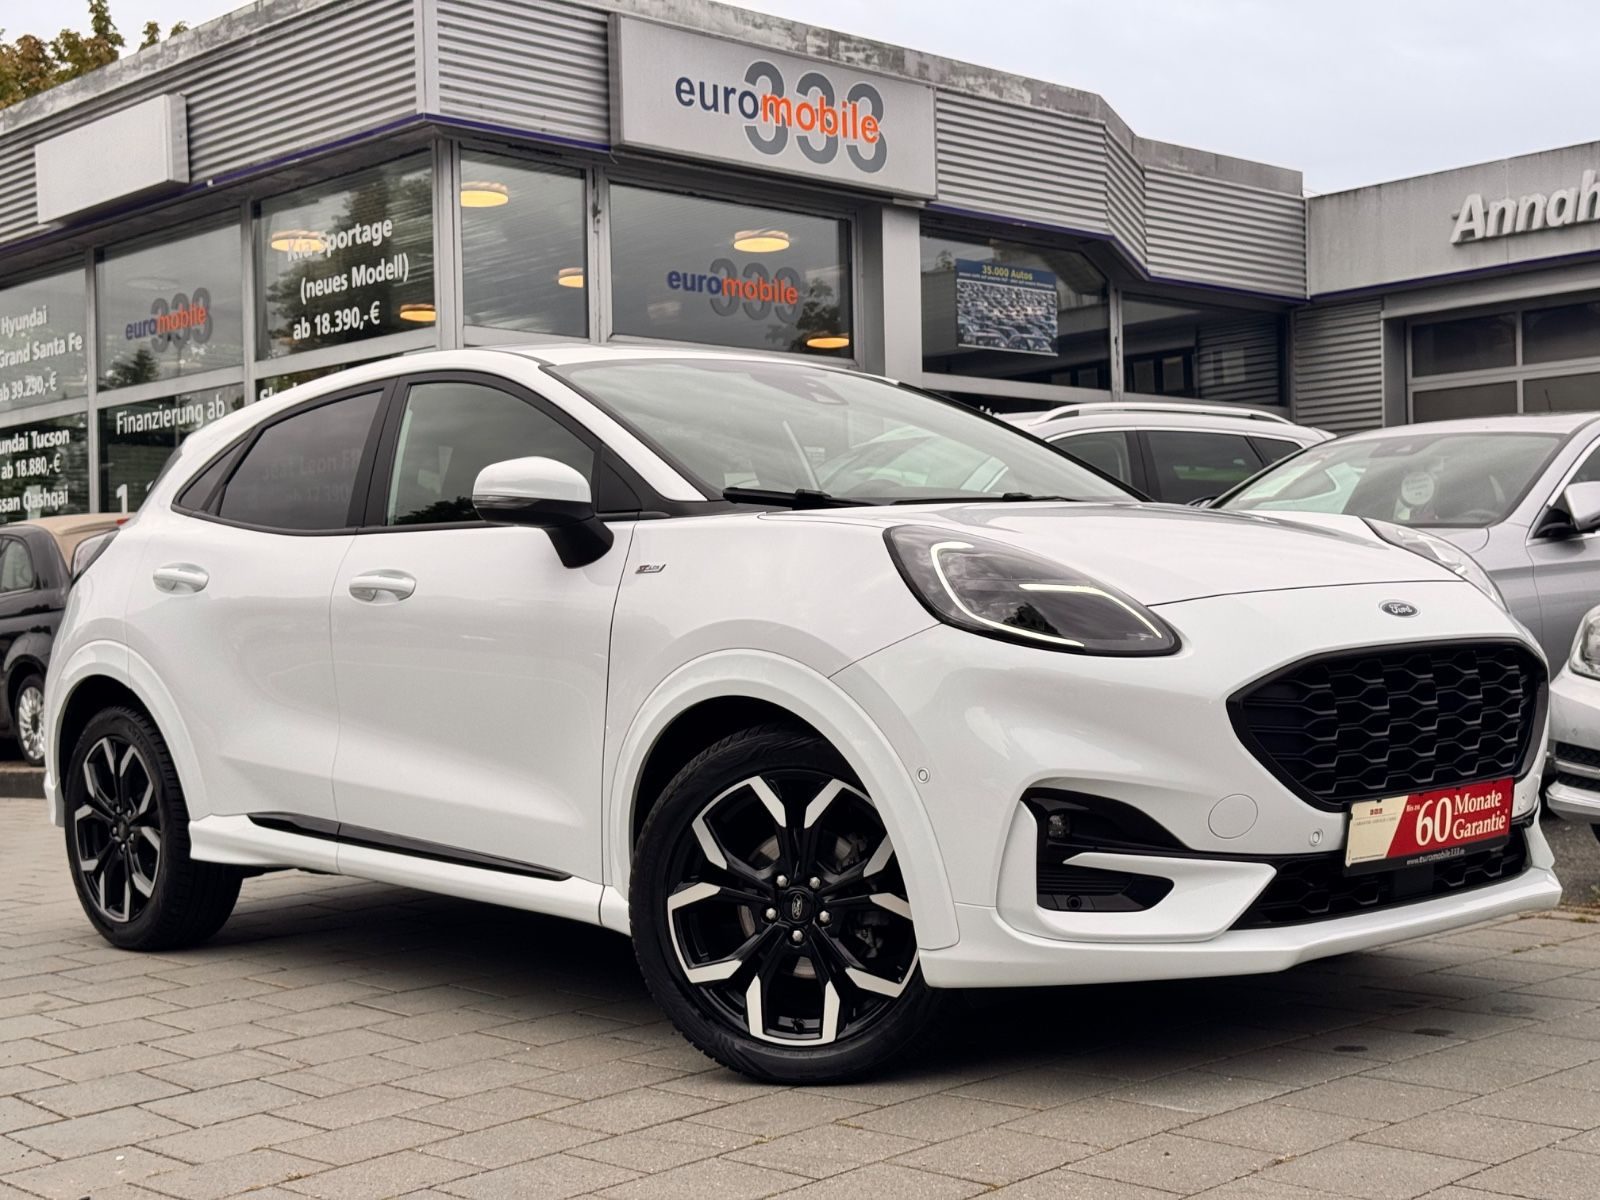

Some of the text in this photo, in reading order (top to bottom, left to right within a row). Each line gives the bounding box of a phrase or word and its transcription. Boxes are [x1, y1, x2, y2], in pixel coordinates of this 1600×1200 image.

[675, 76, 880, 144] euromobile
[744, 61, 887, 173] 333
[1450, 169, 1600, 244] Annah
[319, 219, 393, 257] Sportage
[300, 252, 409, 304] (neues Modell)
[667, 270, 798, 305] euromobile
[982, 264, 1009, 277] 35.000
[1010, 269, 1033, 281] Autos
[1, 304, 47, 338] Hyundai
[126, 302, 208, 340] euromobile
[293, 317, 310, 340] ab
[32, 336, 66, 360] Santa
[68, 332, 83, 352] Fe
[116, 394, 225, 435] Finanzierung ab
[31, 429, 70, 450] Tucson
[1, 457, 13, 480] ab
[23, 484, 69, 511] Qashqai
[1454, 789, 1502, 815] Monate
[1416, 797, 1452, 846] 60
